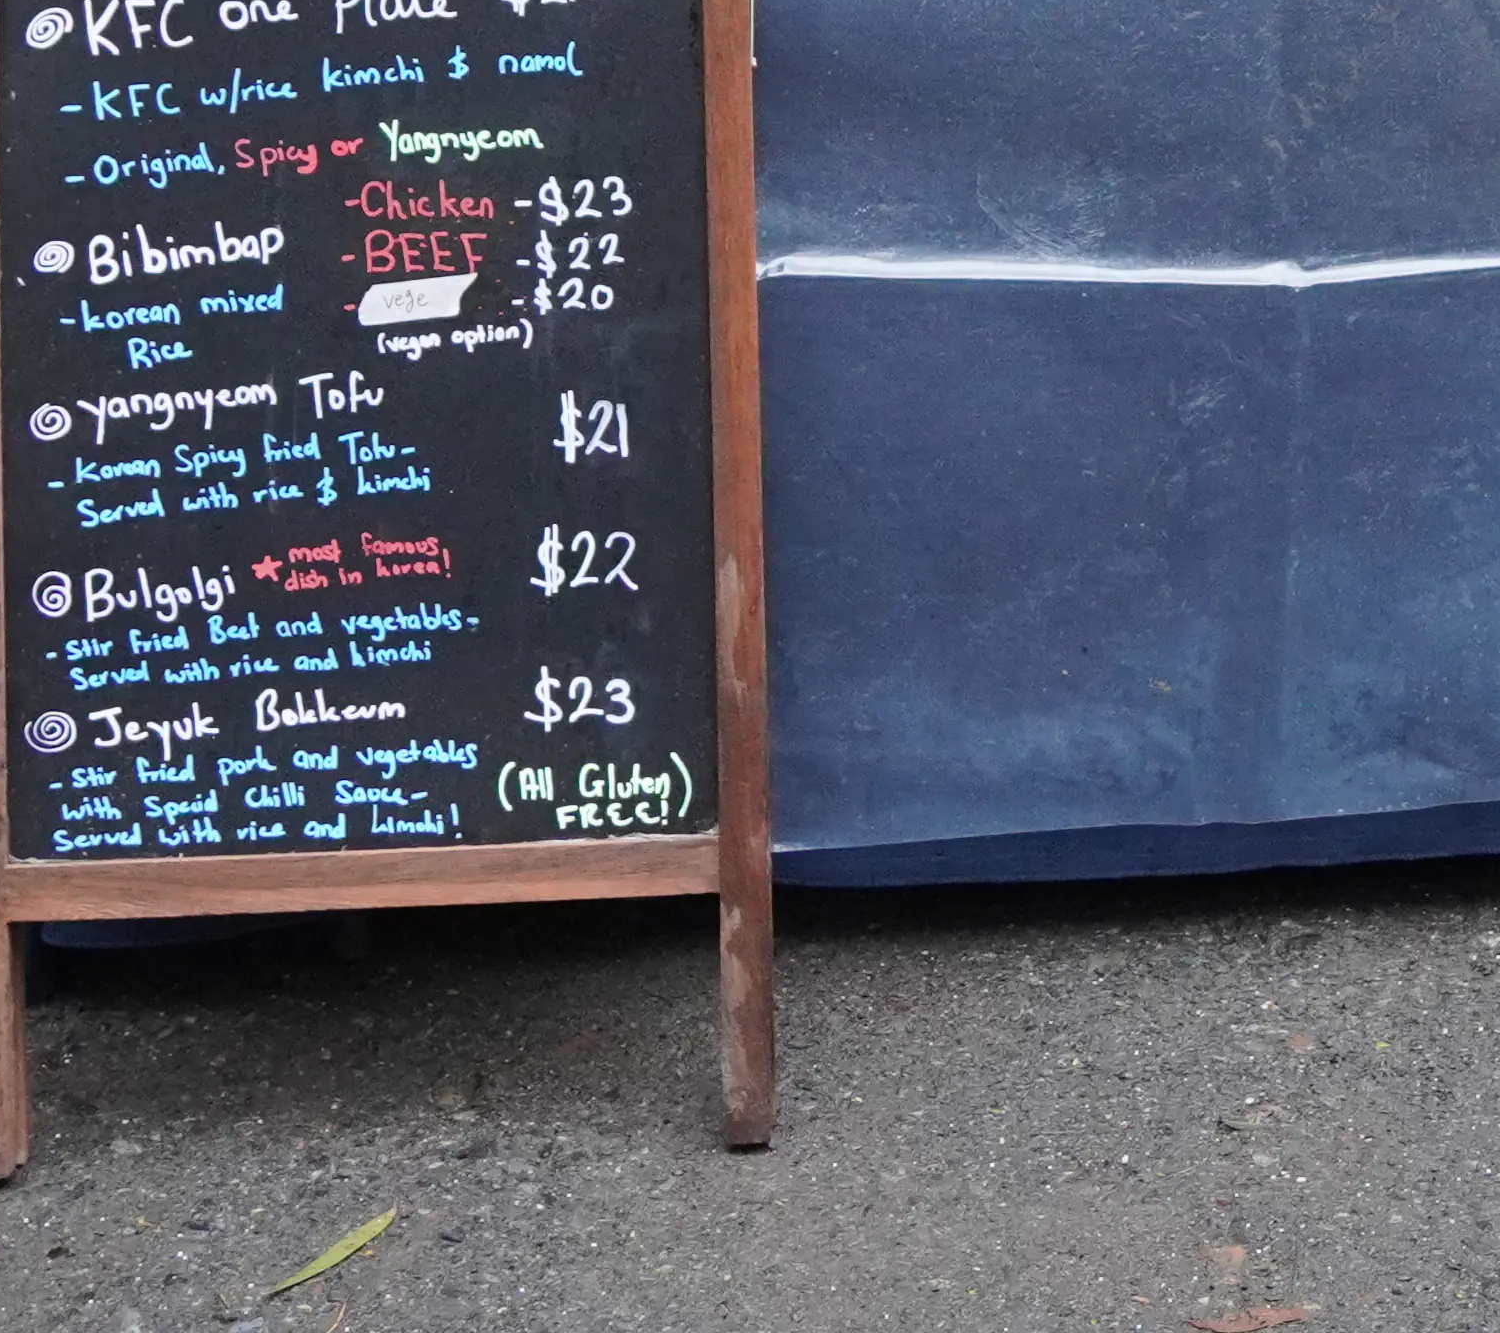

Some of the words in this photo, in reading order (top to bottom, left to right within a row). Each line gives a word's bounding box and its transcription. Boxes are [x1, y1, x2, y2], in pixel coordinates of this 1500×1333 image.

[219, 0, 298, 30] one
[323, 55, 425, 92] kimchi
[235, 138, 317, 176] Spicy
[331, 137, 363, 156] or
[88, 221, 284, 284] Bibimbap
[200, 284, 284, 314] mixed
[383, 290, 428, 309] vege
[128, 338, 193, 369] Rice
[299, 370, 384, 419] Tofu
[553, 390, 628, 463] $21
[174, 444, 246, 477] Spicy
[77, 489, 165, 528] Served
[182, 483, 239, 512] with
[252, 480, 304, 503] rice
[357, 465, 431, 495] kimchi
[288, 539, 342, 564] most
[361, 532, 440, 556] famous
[530, 524, 638, 596] $22
[85, 565, 236, 623] Bulgolgi
[284, 569, 328, 592] dish
[338, 567, 363, 585] in
[275, 611, 323, 637] and
[70, 659, 149, 691] Served
[164, 657, 220, 683] with
[229, 653, 280, 678] rice
[293, 647, 339, 672] and
[350, 641, 432, 667] kimchi
[89, 701, 220, 761] Jeyuk
[524, 666, 635, 732] $23
[218, 745, 276, 786] pork
[293, 744, 339, 770] and
[355, 738, 478, 780] vegetables
[61, 801, 122, 821] with
[157, 816, 222, 846] with
[236, 821, 287, 841] rice
[303, 813, 347, 840] and
